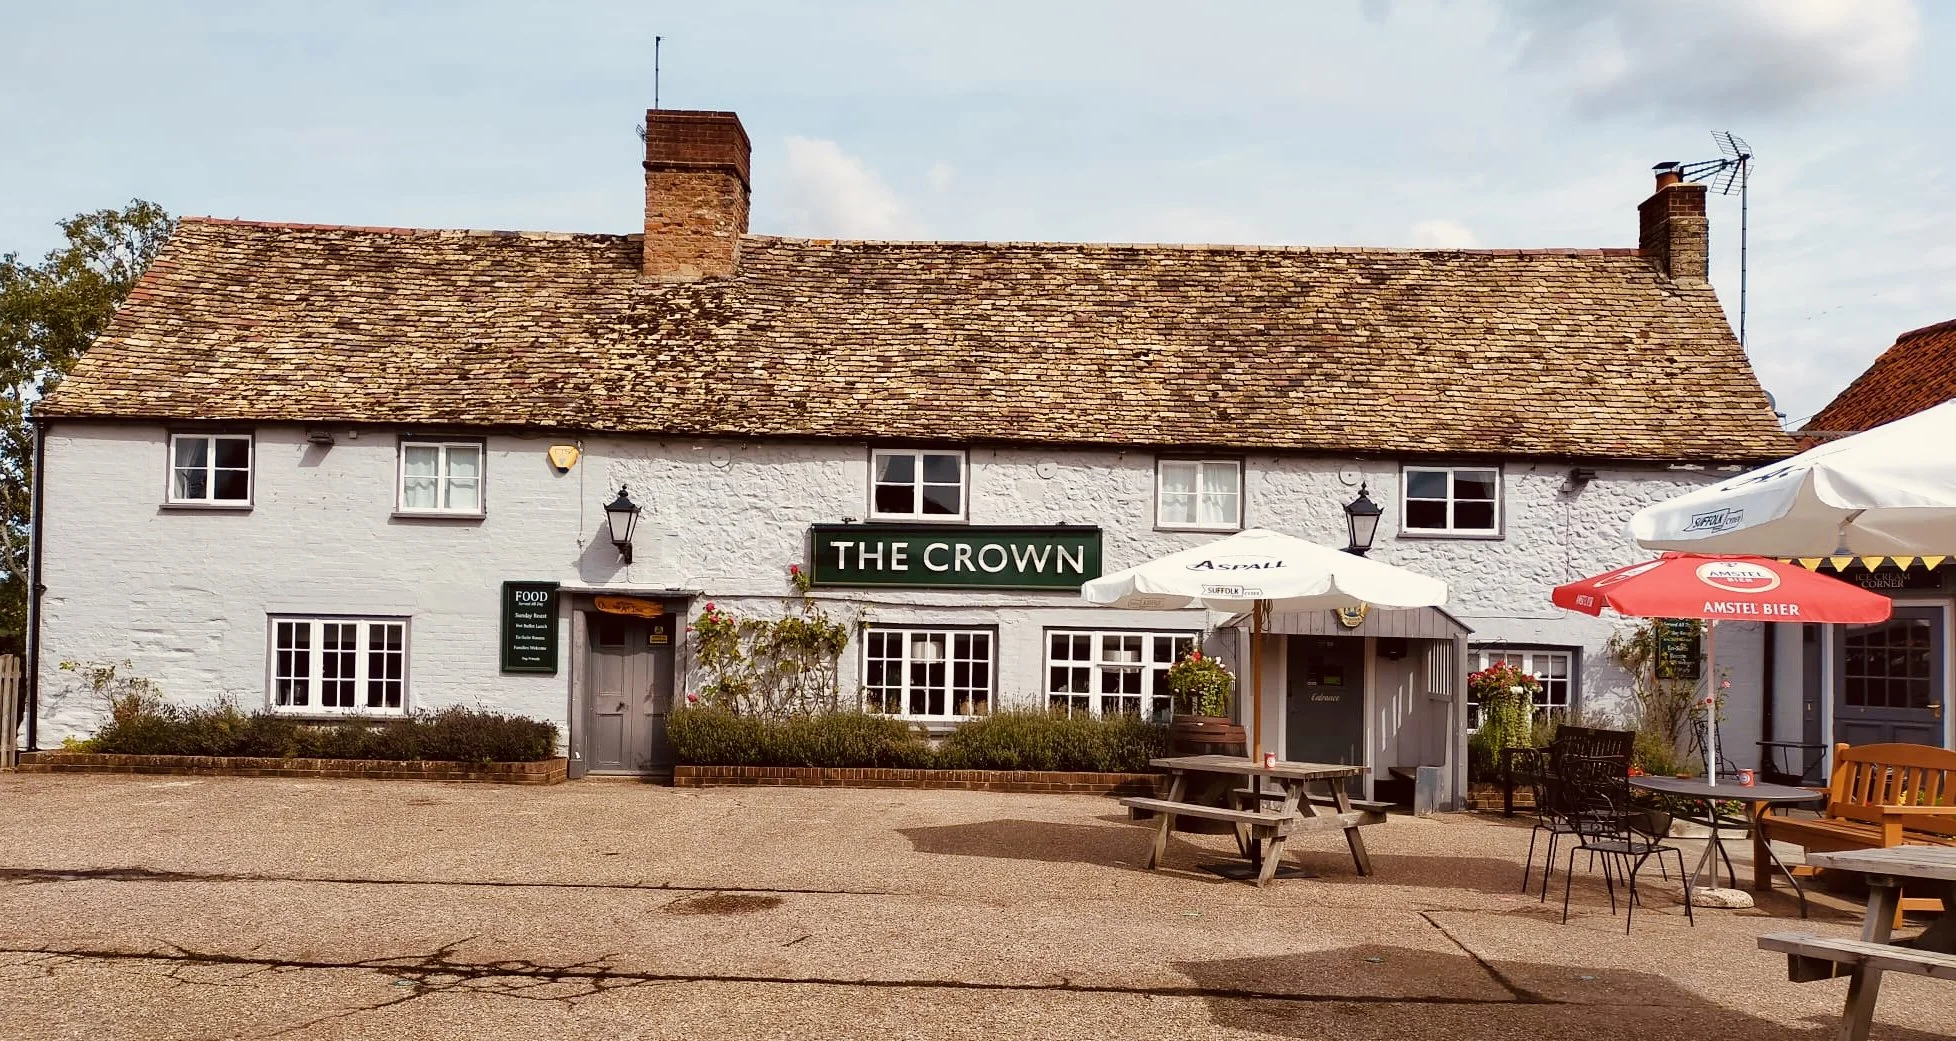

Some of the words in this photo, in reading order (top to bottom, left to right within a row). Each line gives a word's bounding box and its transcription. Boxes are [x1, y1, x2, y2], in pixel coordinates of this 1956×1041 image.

[1693, 513, 1724, 528] SUFFOLK
[830, 541, 908, 571] THE
[923, 542, 1084, 574] CROWN
[1855, 573, 1871, 581] ICE
[1874, 572, 1911, 580] CREAM
[1861, 580, 1905, 588] CORNER
[1207, 587, 1239, 595] SUFFOLK
[515, 591, 548, 602] FOOD
[1703, 601, 1759, 615] AMSTEL
[1763, 603, 1800, 615] BIER
[1311, 692, 1340, 702] Entrance
